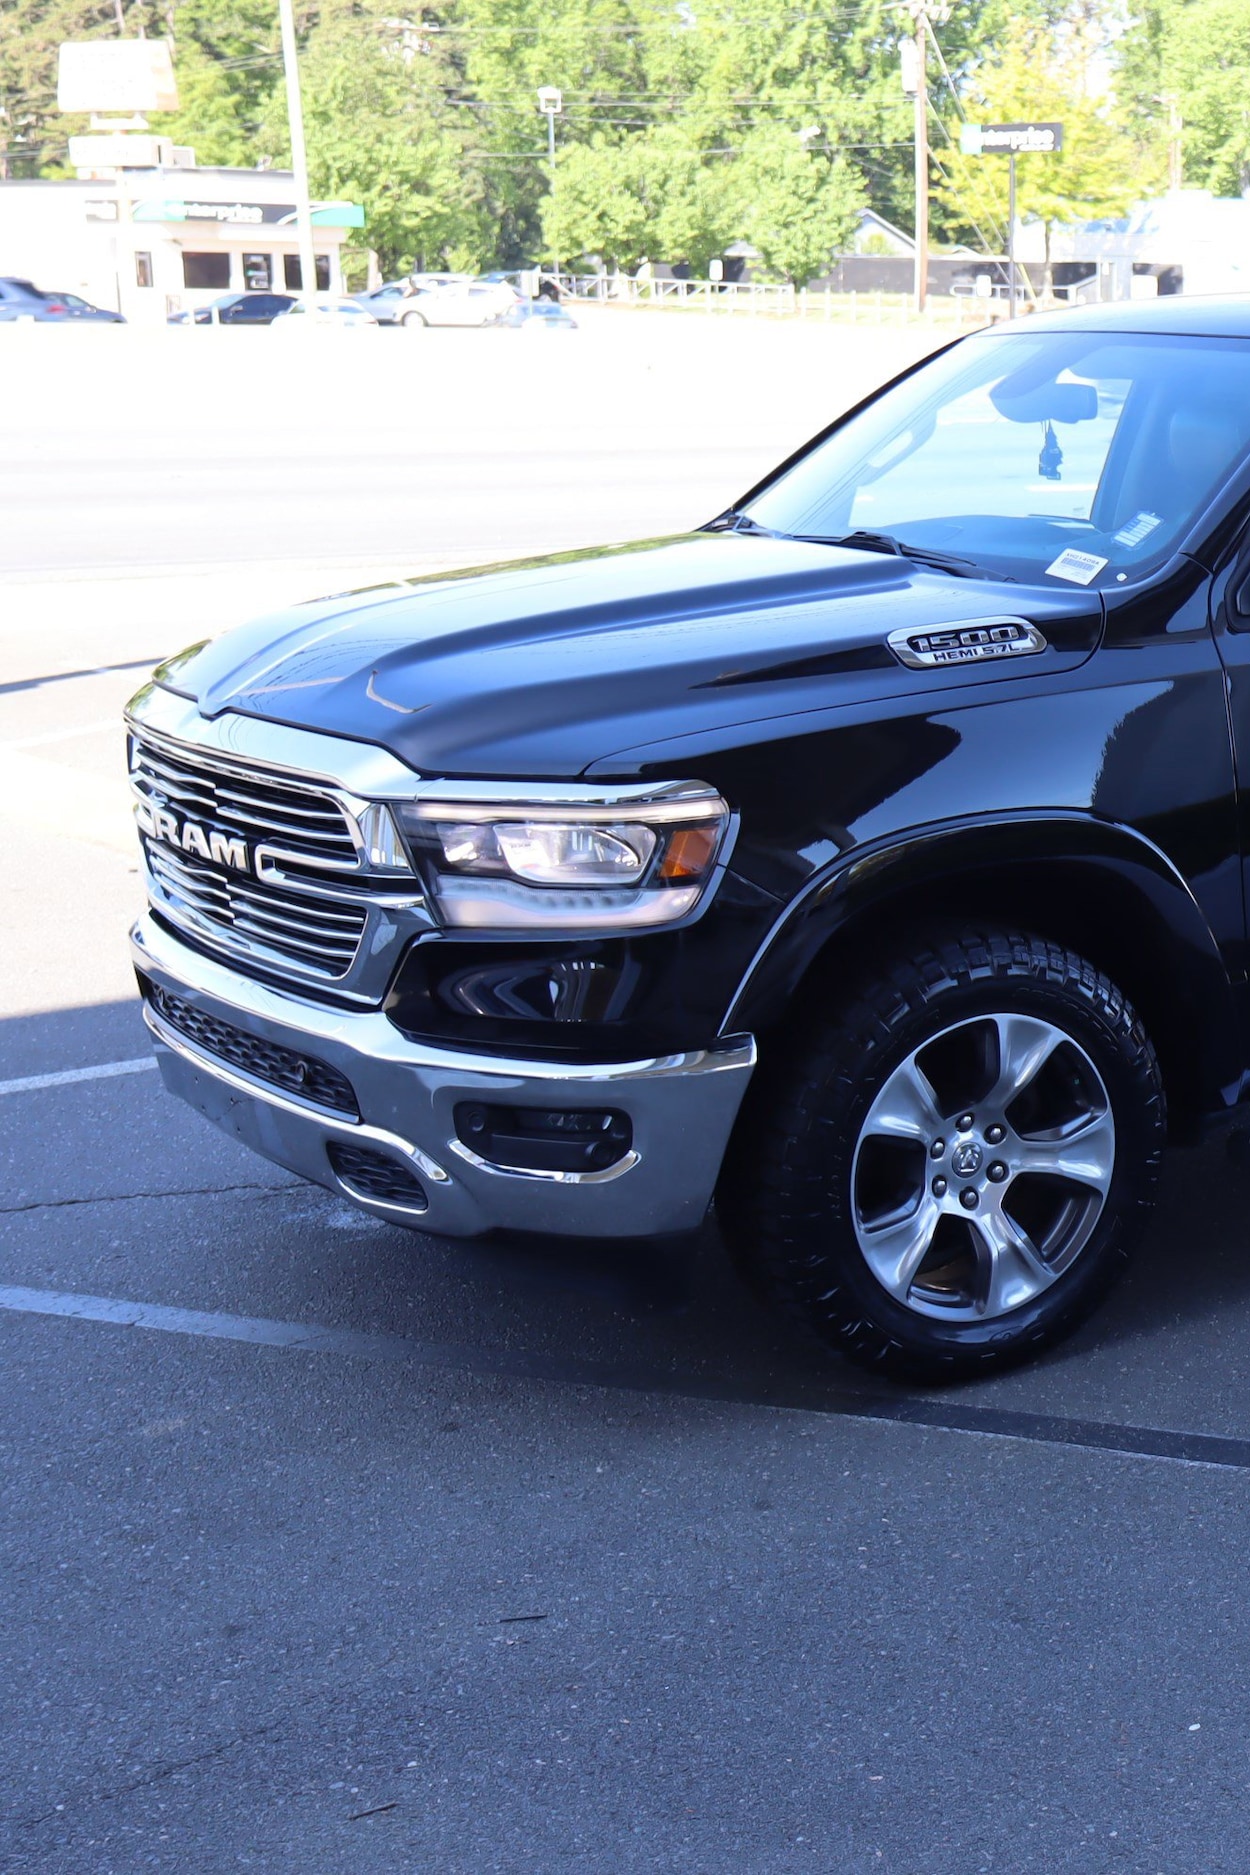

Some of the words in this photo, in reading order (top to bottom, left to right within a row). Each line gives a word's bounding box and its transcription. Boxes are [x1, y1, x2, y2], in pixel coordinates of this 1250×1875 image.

[911, 626, 1021, 652] 1500
[933, 649, 979, 662] HEMI
[982, 643, 1022, 655] 5.7L
[156, 807, 252, 874] RAM
